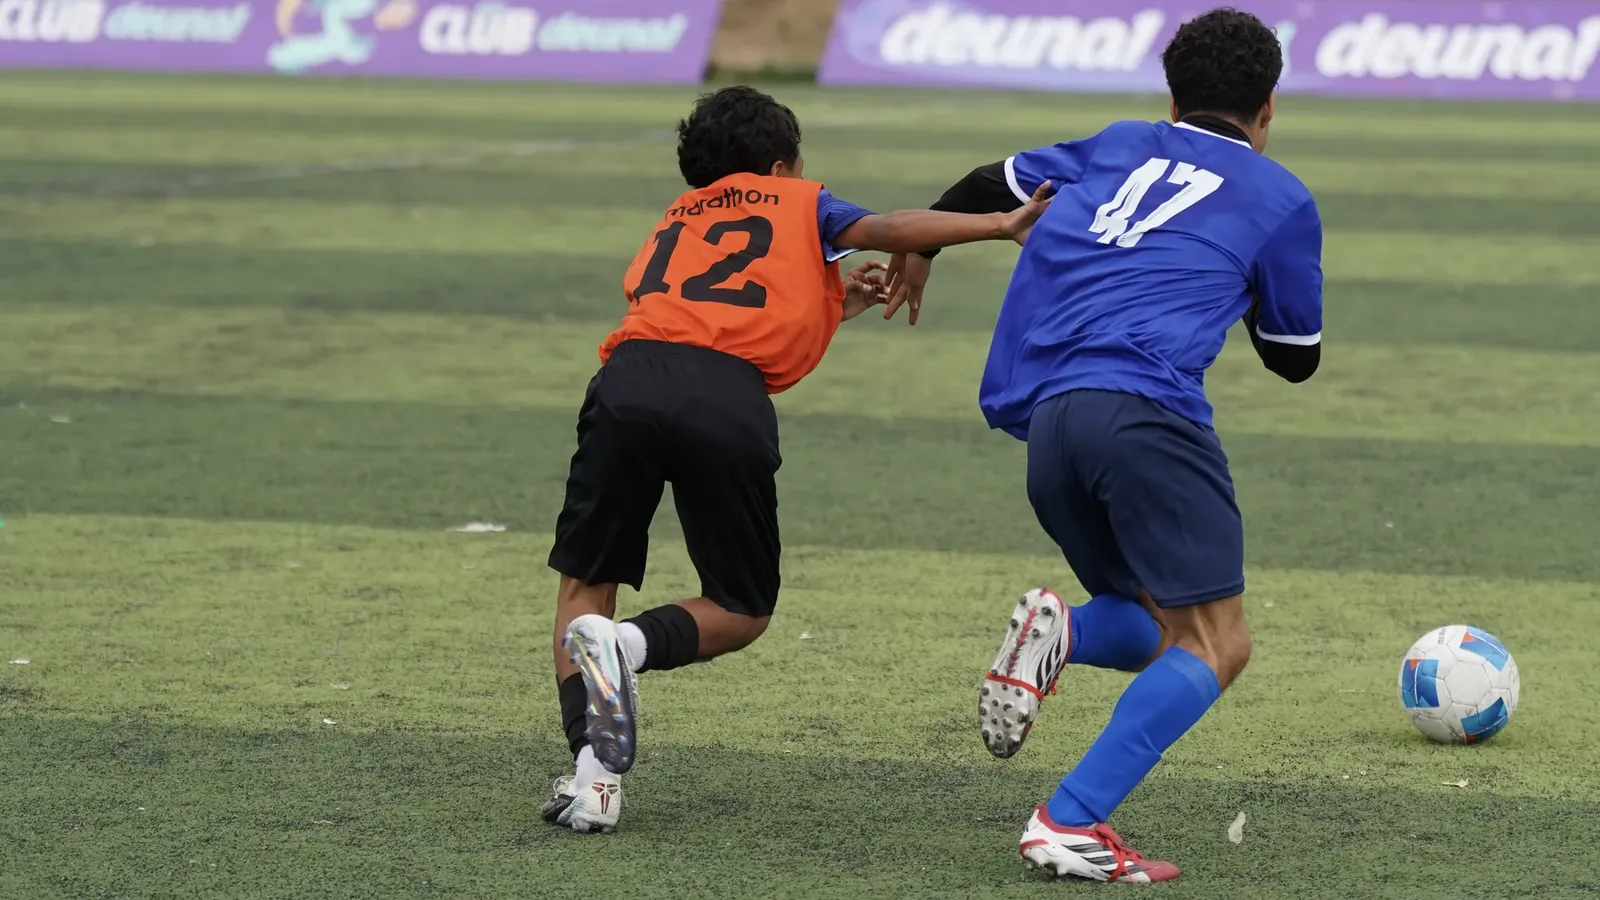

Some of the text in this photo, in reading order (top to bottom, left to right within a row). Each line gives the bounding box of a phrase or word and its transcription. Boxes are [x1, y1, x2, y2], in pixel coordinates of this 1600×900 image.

[419, 4, 537, 55] CLUB
[665, 186, 779, 221] marathon
[1088, 157, 1225, 248] 47
[632, 215, 774, 309] 12
